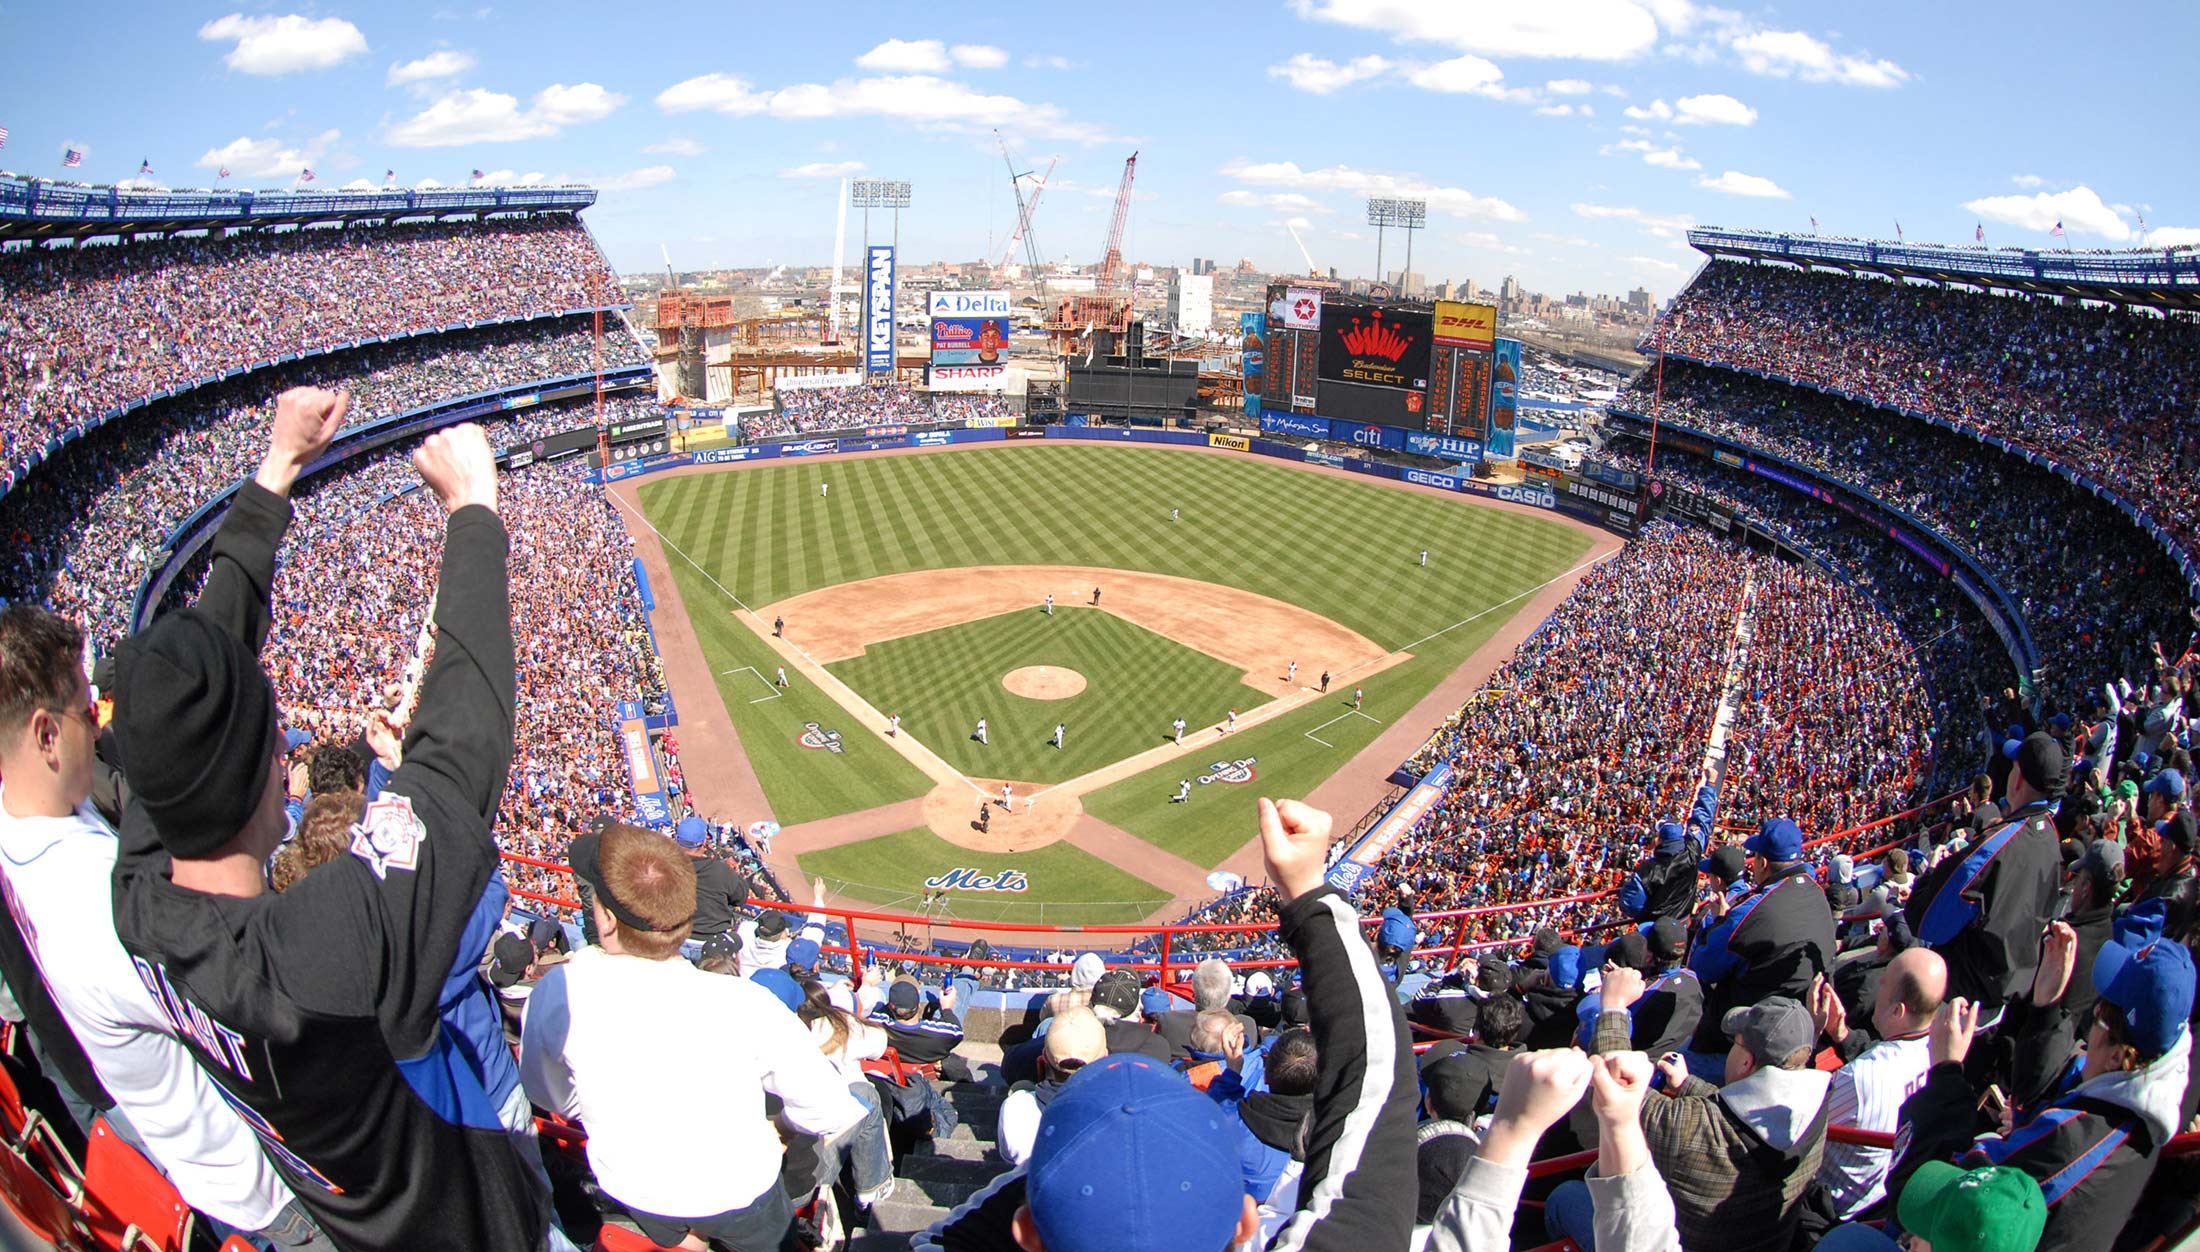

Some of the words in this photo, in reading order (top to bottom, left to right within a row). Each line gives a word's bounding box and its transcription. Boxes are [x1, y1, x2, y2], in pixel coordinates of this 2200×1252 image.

[870, 248, 892, 352] KEYSPAN
[956, 295, 1008, 312] Delta
[934, 321, 974, 340] Phillies
[1440, 316, 1488, 330] DHL
[948, 341, 971, 349] BURRELL
[1243, 351, 1263, 360] PEPS
[935, 367, 1004, 379] SHARP
[1352, 359, 1396, 372] Budweiser
[1342, 368, 1405, 385] SELECT
[621, 419, 664, 433] AMERITRADE
[1311, 423, 1329, 433] Sun
[1214, 436, 1245, 449] Nikon
[1353, 428, 1381, 446] citi
[808, 442, 837, 450] LIGHT
[1441, 437, 1480, 454] HIP
[695, 451, 716, 463] AIG
[1306, 450, 1344, 463] amtrak.com
[1407, 471, 1455, 489] GEICO
[1497, 485, 1556, 508] CASIO
[1197, 765, 1238, 784] OPENING
[924, 867, 1030, 893] Mets
[1328, 862, 1363, 891] Mets
